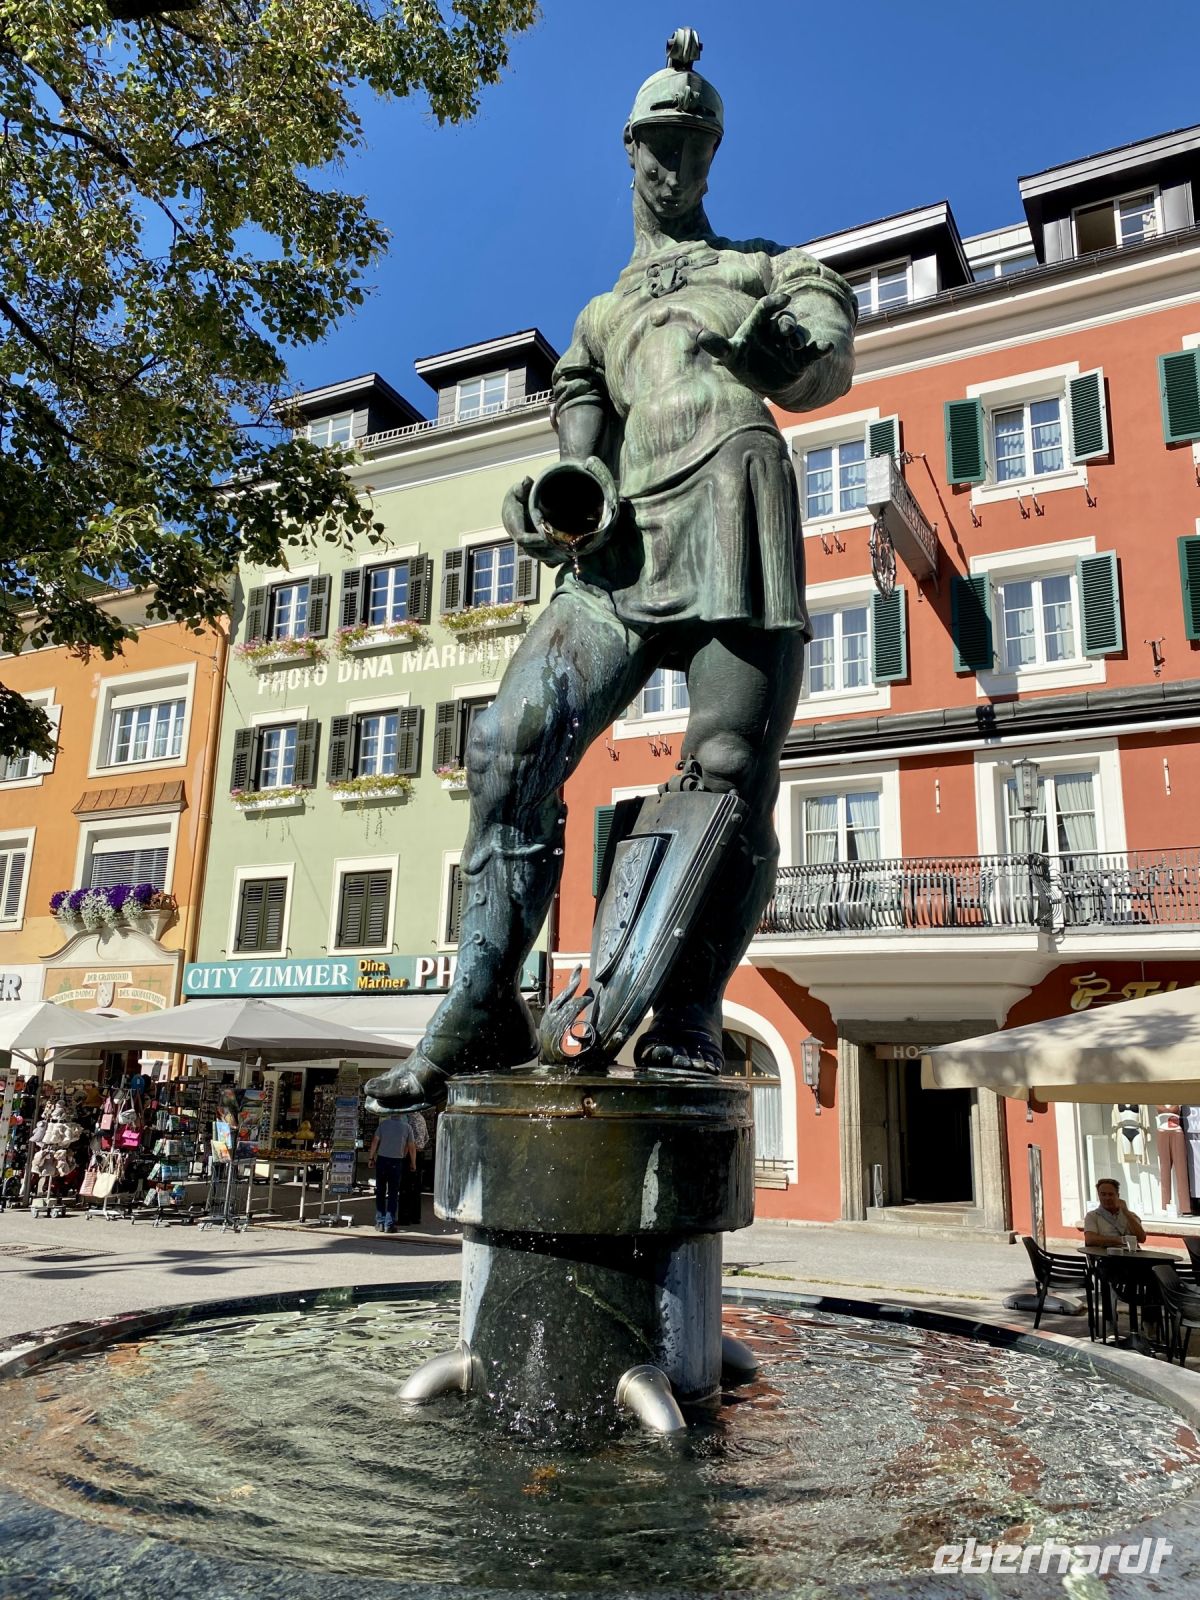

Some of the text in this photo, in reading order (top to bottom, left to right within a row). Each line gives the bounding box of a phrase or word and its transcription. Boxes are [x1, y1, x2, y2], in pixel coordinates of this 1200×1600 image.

[258, 664, 328, 694] PHOTO
[337, 654, 394, 683] DINA
[358, 959, 387, 972] Dina
[186, 964, 351, 990] CITY ZIMMER
[357, 975, 406, 989] Mariner
